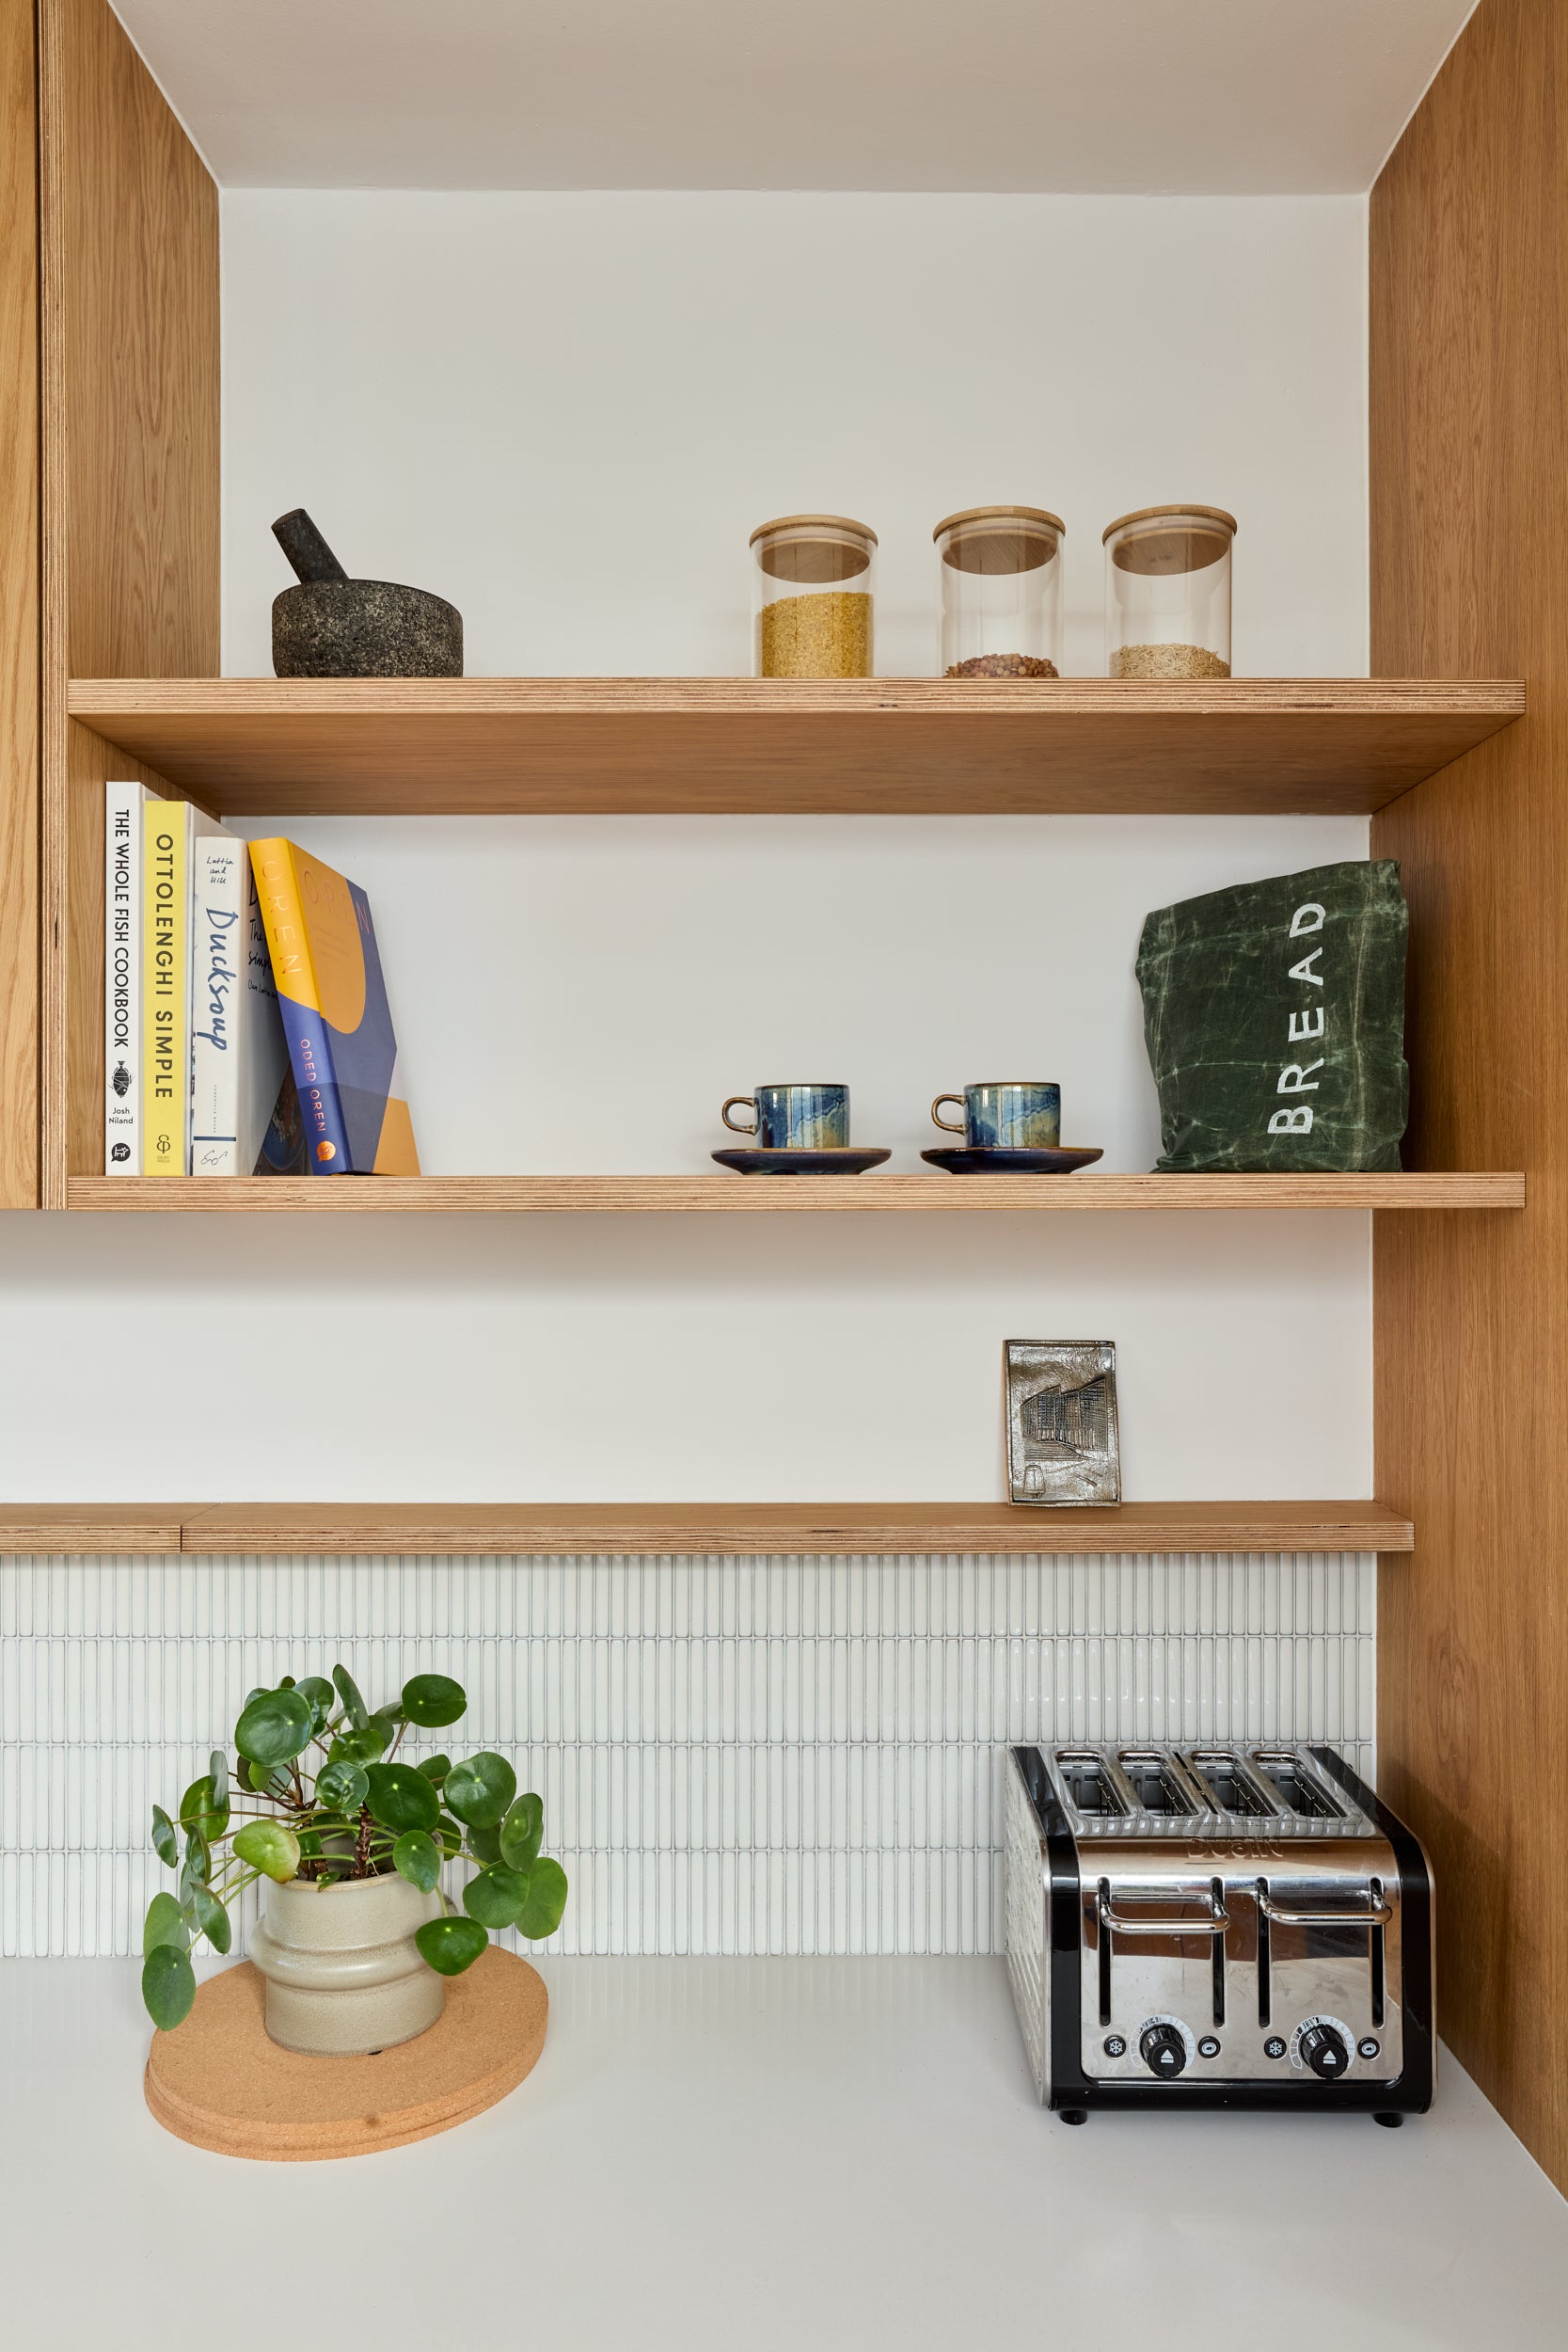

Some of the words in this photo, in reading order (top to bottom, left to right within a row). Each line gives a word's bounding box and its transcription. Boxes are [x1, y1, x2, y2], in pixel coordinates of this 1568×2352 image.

[114, 809, 130, 837] THE
[114, 842, 130, 902] WHOLE
[206, 855, 234, 865] Lattin
[209, 866, 227, 875] and
[210, 876, 227, 884] Hill
[114, 908, 130, 942] FISH
[155, 834, 174, 995] OTTOLENGHI
[261, 860, 302, 975] OREN
[114, 946, 130, 1048] COOKBOOK
[196, 907, 240, 1051] Ducksoup
[1266, 901, 1327, 1135] BREAD
[155, 1010, 173, 1098] SIMPLE
[112, 1106, 131, 1116] Josh
[300, 1038, 318, 1083] ODED
[309, 1089, 327, 1132] OREN
[108, 1116, 134, 1125] Niland
